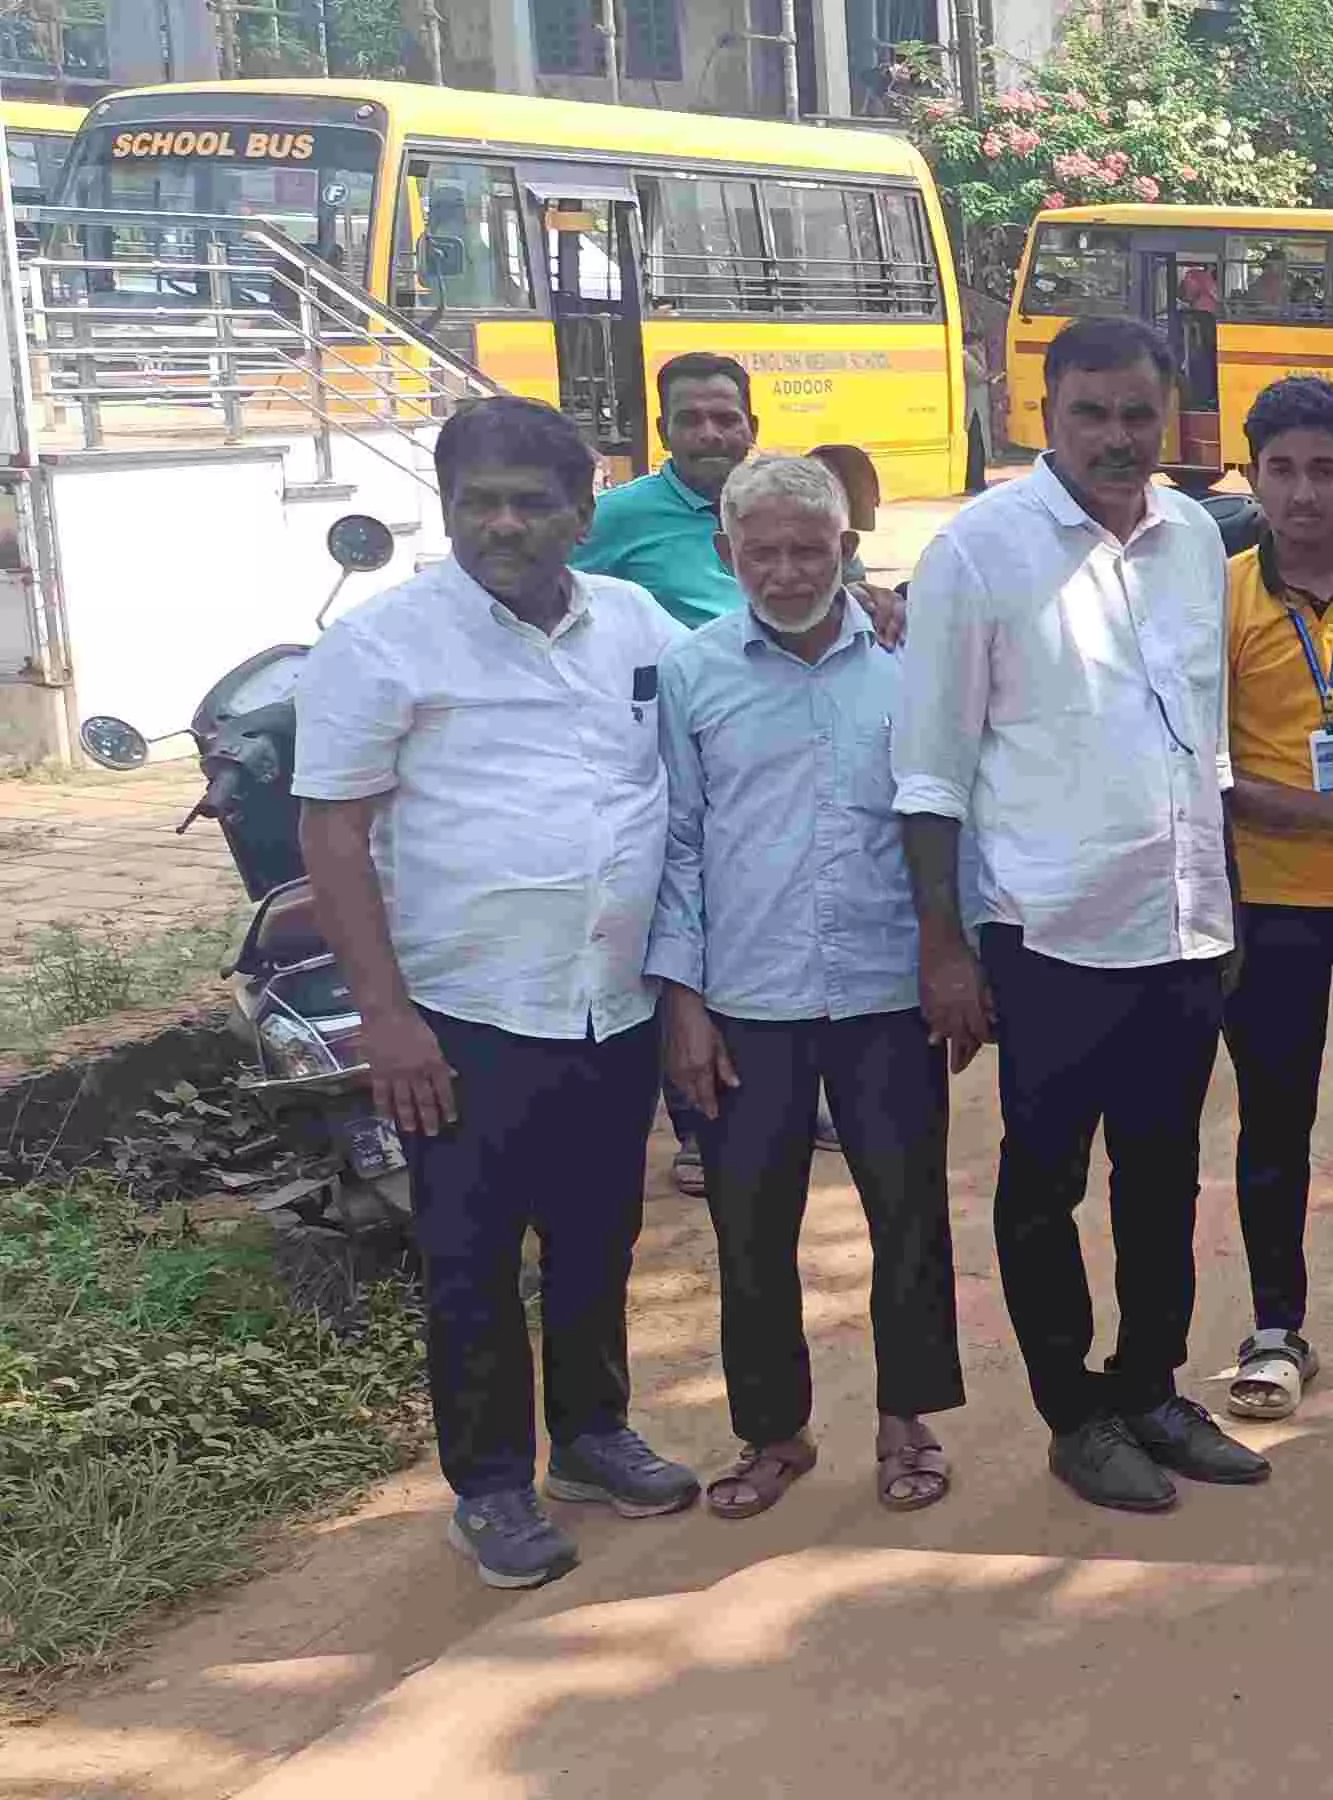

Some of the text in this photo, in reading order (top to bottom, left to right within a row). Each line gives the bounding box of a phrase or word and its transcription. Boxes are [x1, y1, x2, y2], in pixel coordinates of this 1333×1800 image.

[113, 131, 315, 160] SCHOOL BUS
[328, 186, 343, 202] F
[773, 379, 834, 397] ADDOOR
